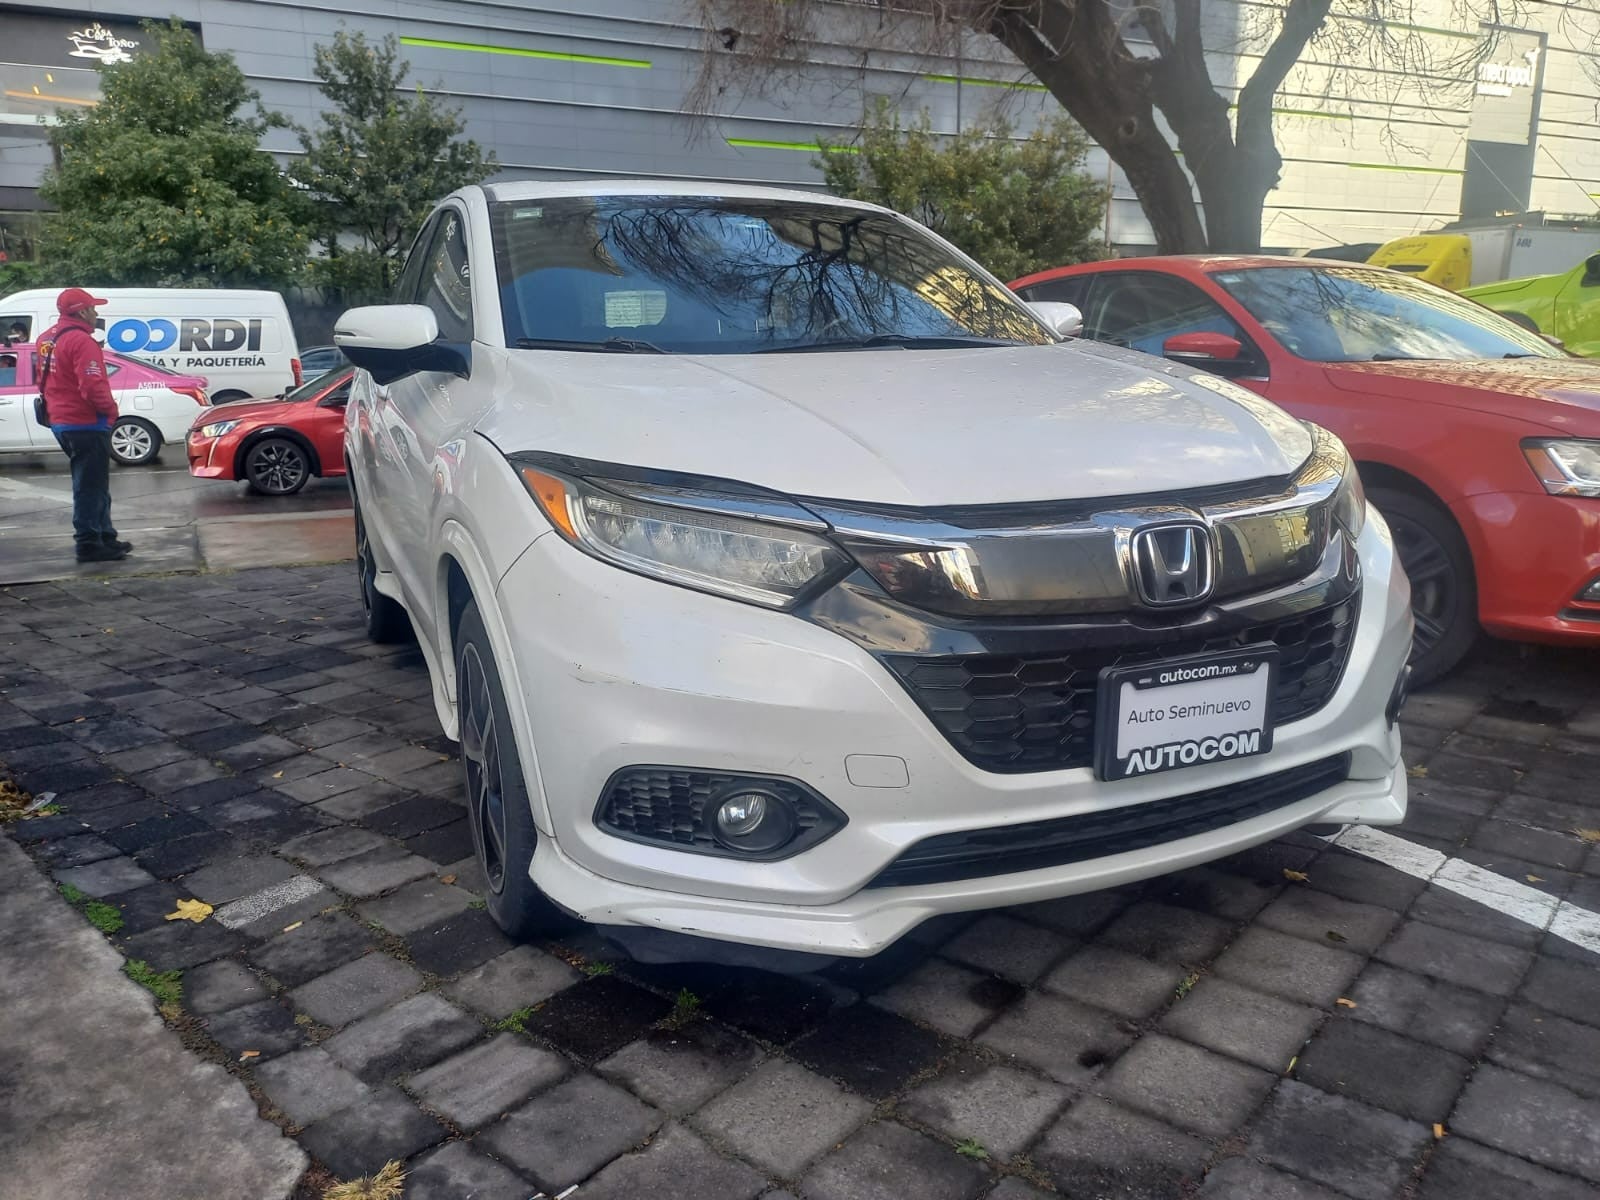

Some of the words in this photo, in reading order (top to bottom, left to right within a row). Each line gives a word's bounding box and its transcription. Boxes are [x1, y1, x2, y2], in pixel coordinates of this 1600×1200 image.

[84, 28, 113, 38] CASA
[172, 358, 181, 367] Y
[187, 354, 266, 367] PAQUETERÍA
[1159, 663, 1238, 684] autocom.mx
[1127, 708, 1165, 725] Auto
[1168, 699, 1252, 720] Seminuevo
[1125, 731, 1261, 776] AUTOCOM
